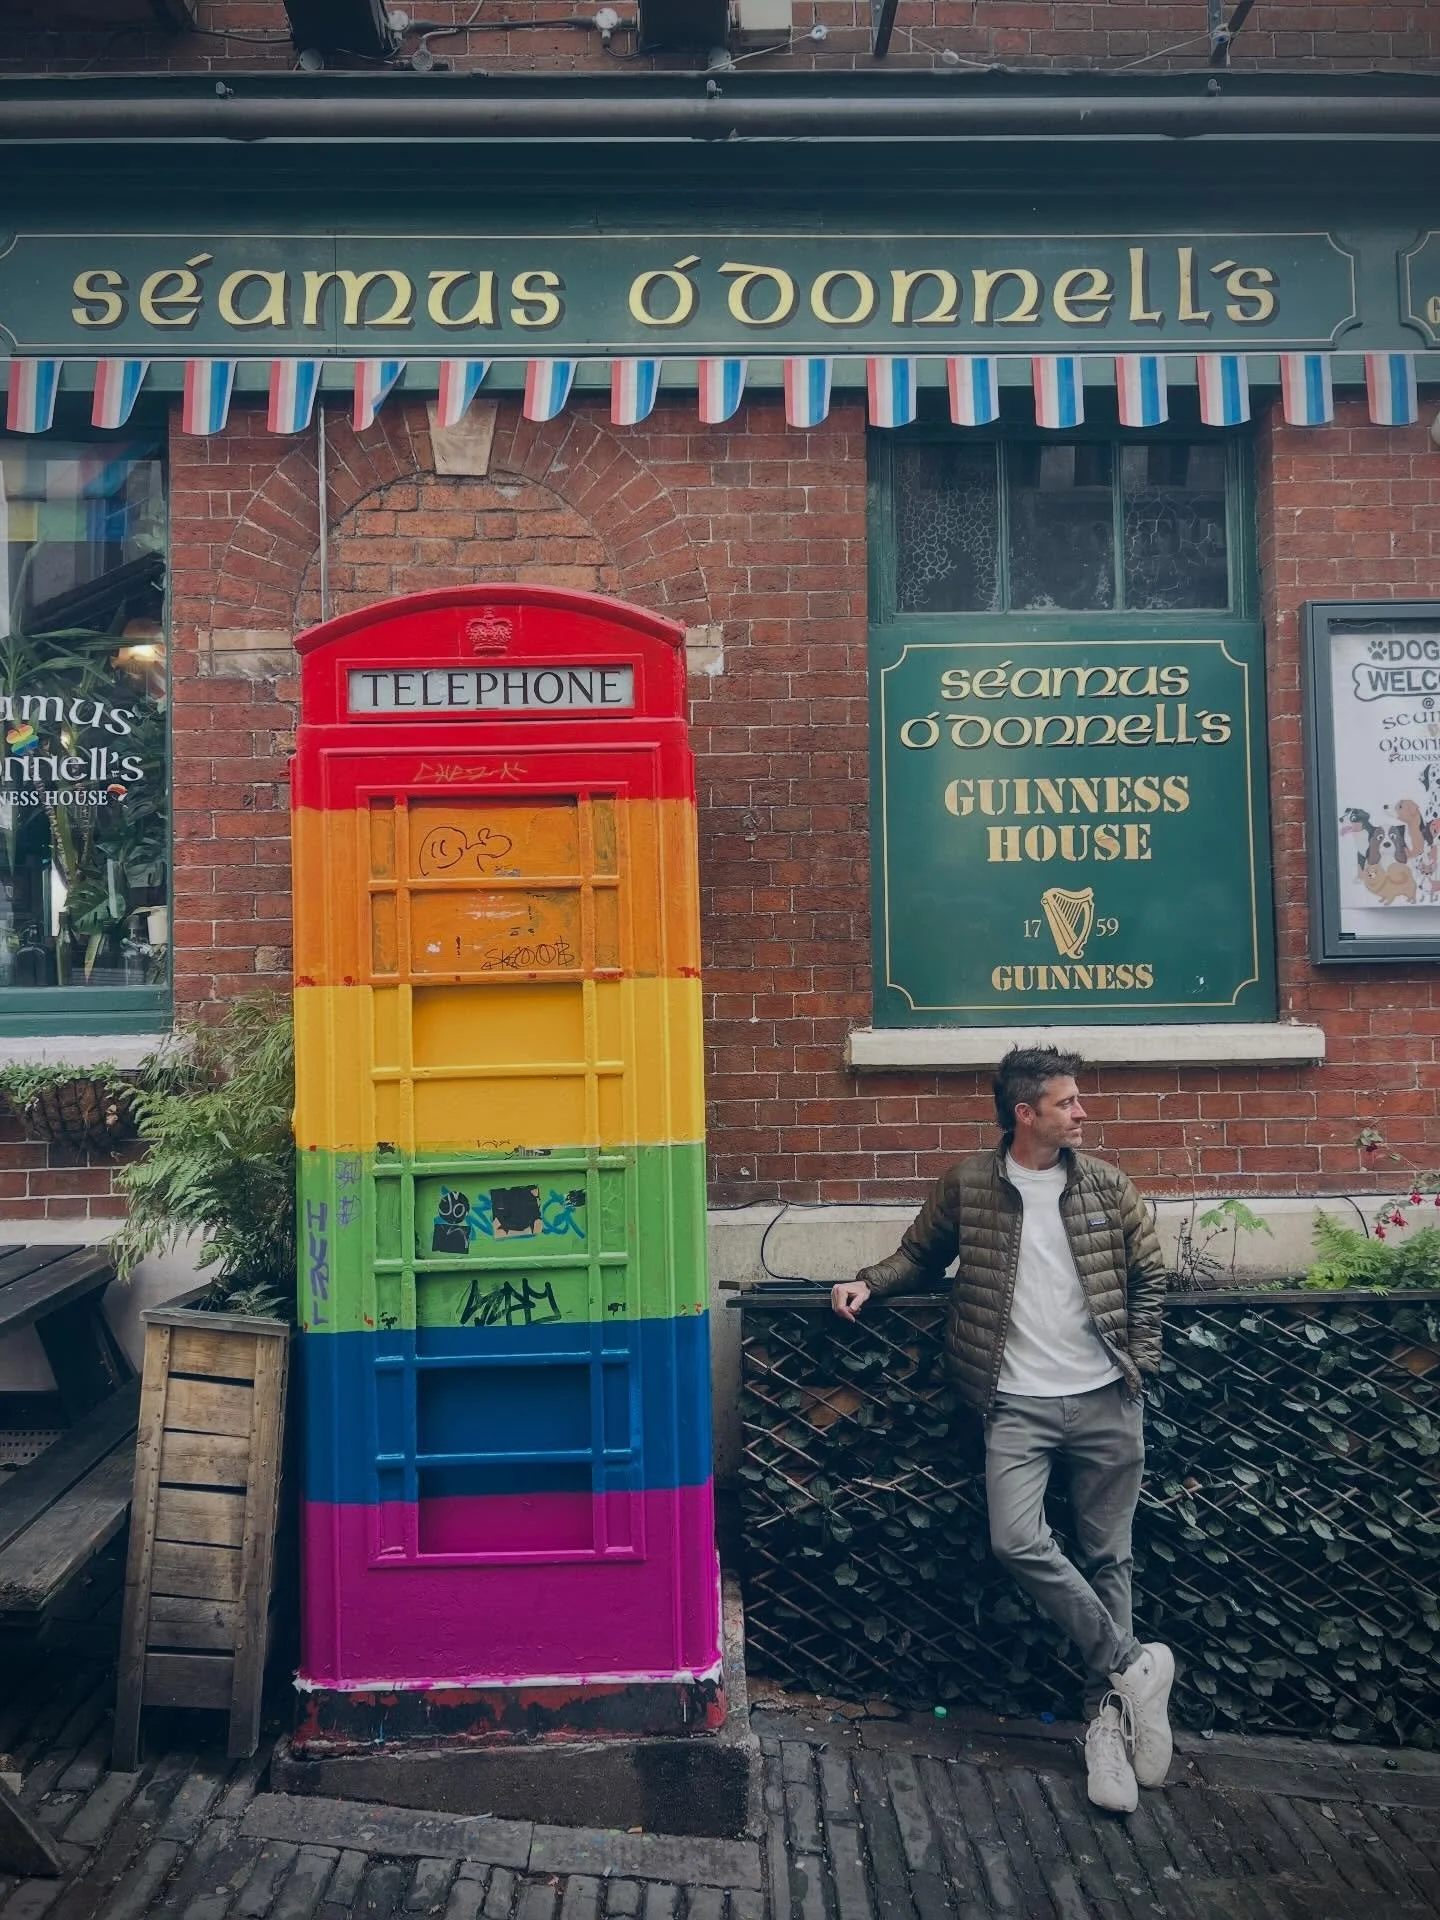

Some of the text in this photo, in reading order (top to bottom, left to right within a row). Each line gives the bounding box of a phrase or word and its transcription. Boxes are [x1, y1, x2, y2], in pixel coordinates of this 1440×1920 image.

[361, 671, 623, 707] TELEPHONE
[1367, 670, 1440, 692] WELC
[0, 746, 144, 782] nnell's
[45, 790, 109, 806] HOUSE
[943, 775, 1191, 816] GUINNESS
[986, 823, 1153, 862] HOUSE
[1022, 918, 1119, 938] 17 59
[990, 963, 1155, 992] GUINNESS
